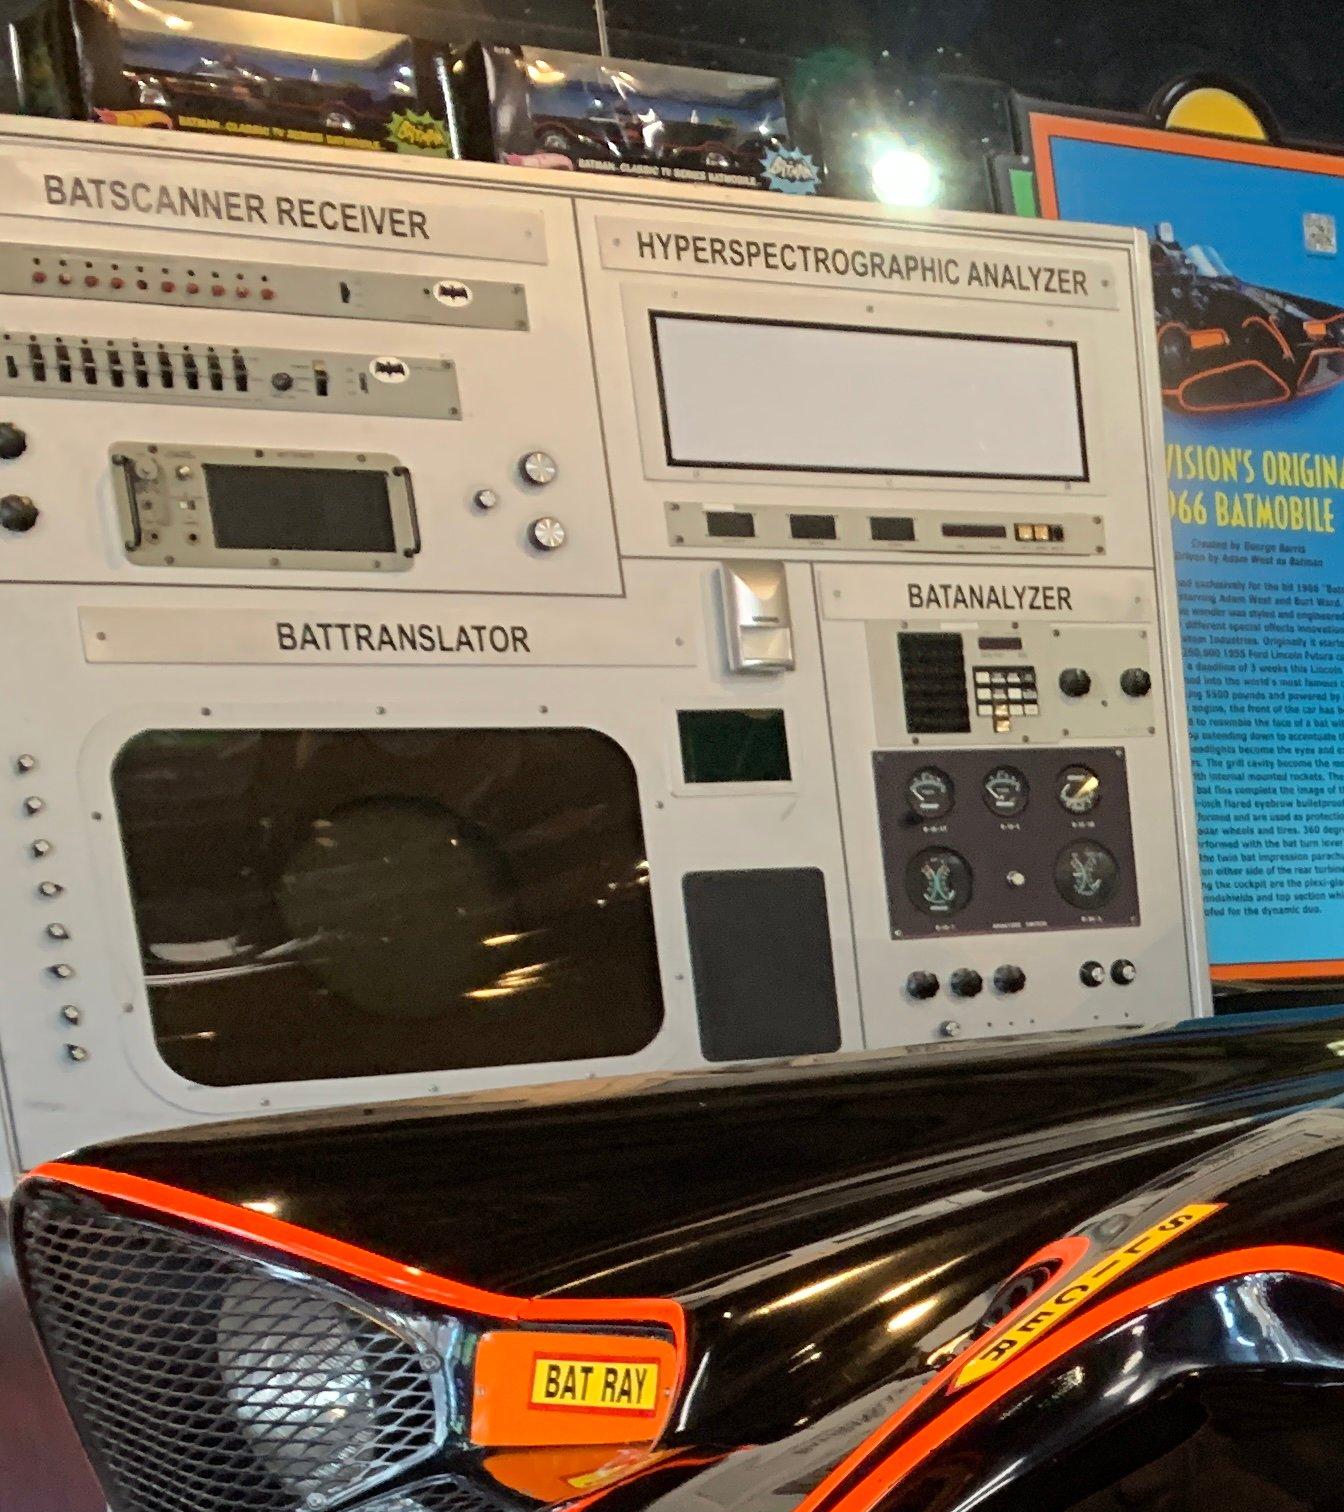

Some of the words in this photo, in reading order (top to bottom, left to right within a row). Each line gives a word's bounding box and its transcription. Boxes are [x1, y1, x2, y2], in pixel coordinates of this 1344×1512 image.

[43, 174, 267, 225] BATSCANNER
[277, 197, 430, 240] RECEIVER
[637, 231, 960, 285] HYPERSPECTROGRAPHIC
[967, 260, 1088, 296] ANALYZER
[1215, 491, 1335, 534] BATMOBILE
[907, 583, 1072, 611] BATANALYZER
[276, 622, 531, 653] BATTRANSLATOR
[980, 1214, 1193, 1362] SLICER
[544, 1364, 594, 1400] BAT
[601, 1367, 647, 1404] RAY
